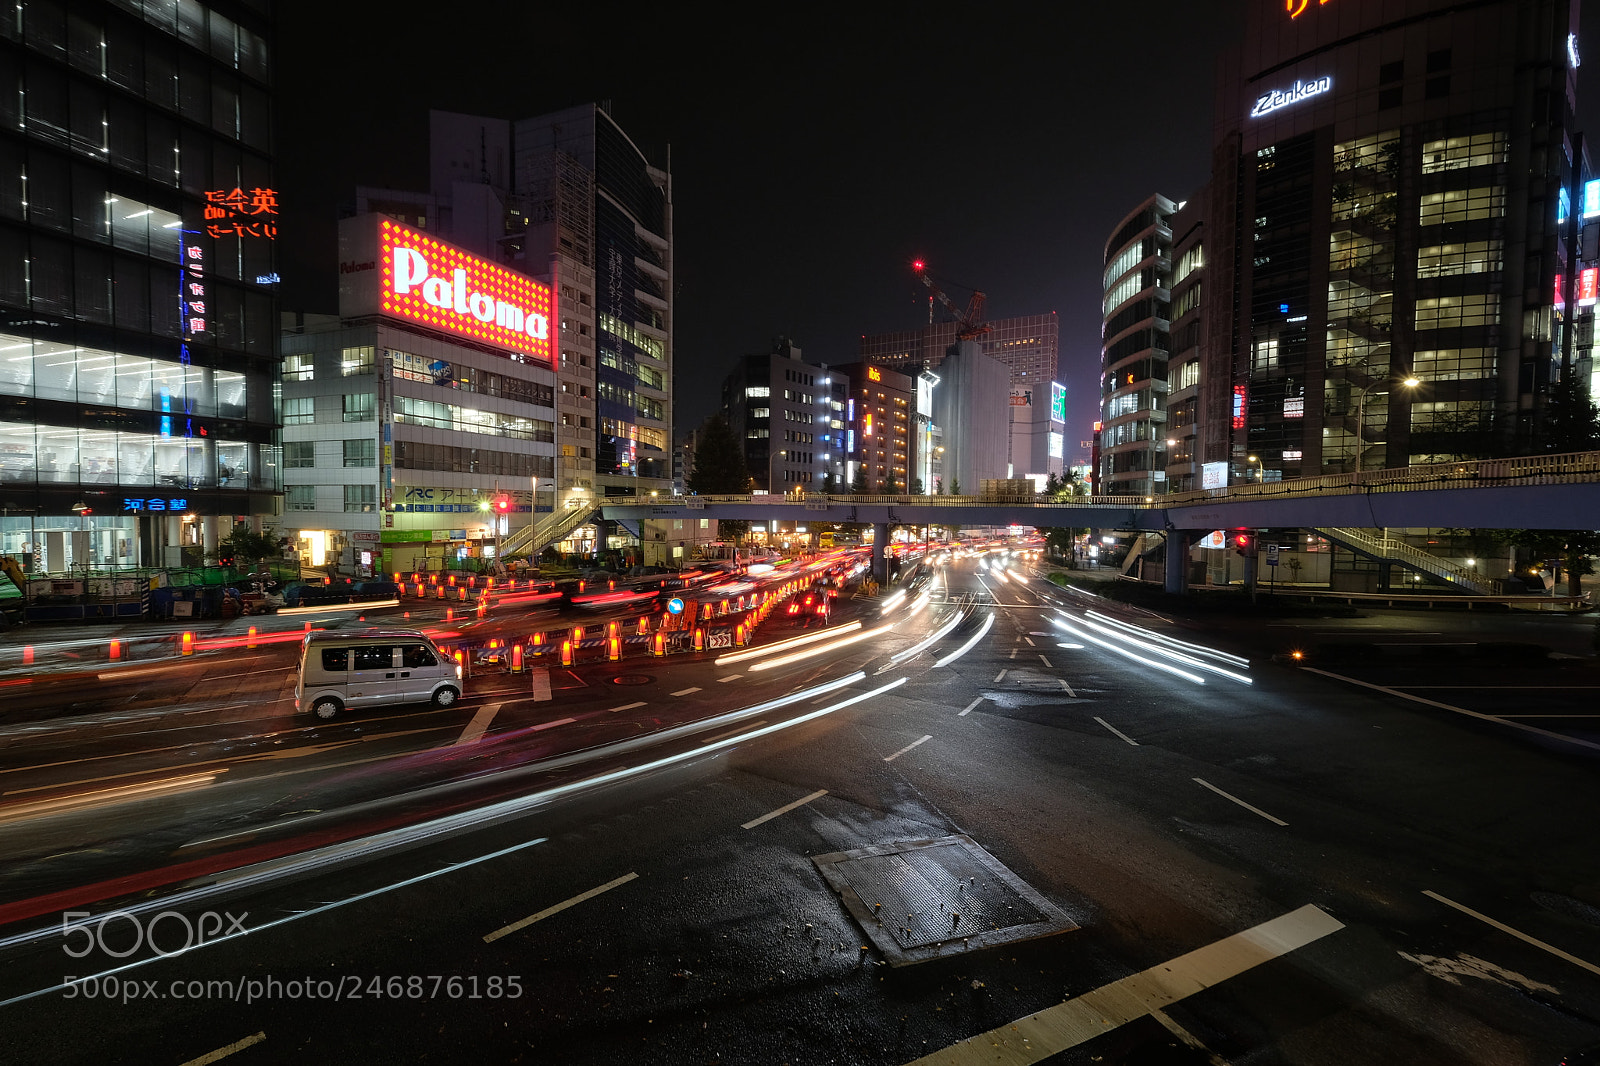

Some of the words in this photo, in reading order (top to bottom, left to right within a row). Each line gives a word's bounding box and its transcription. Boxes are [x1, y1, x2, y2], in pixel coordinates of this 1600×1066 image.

[1251, 77, 1331, 117] Zenken
[340, 260, 376, 274] Paloma
[393, 246, 548, 340] Paloma
[868, 366, 881, 382] ibis
[124, 498, 187, 511] 河合塾
